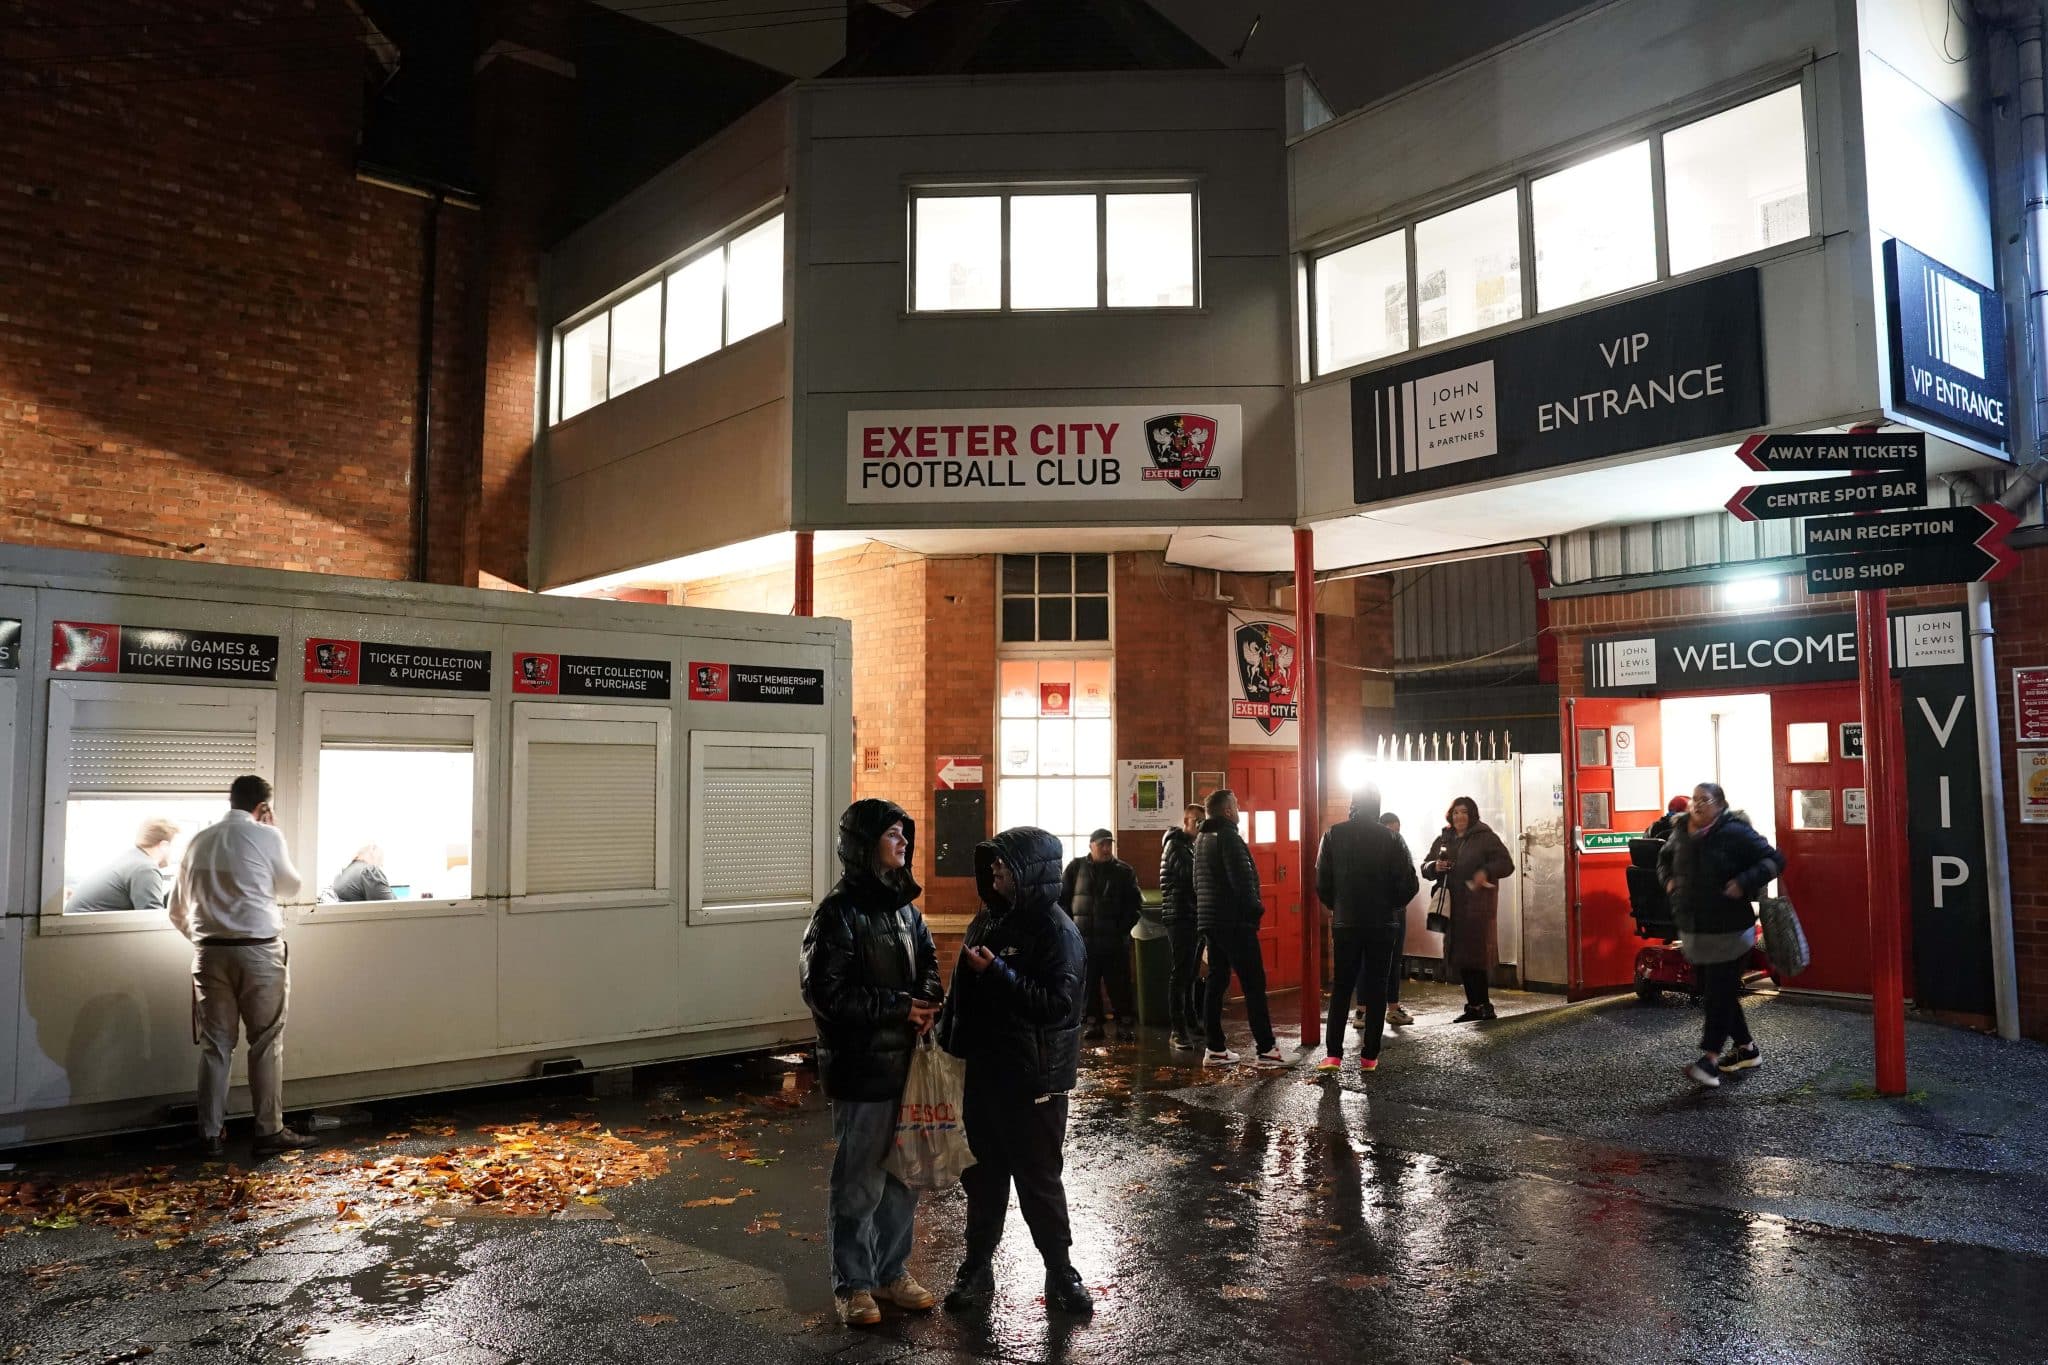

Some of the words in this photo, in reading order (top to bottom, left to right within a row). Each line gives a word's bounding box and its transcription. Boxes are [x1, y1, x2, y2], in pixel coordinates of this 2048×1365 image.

[1600, 332, 1649, 369] VIP
[1432, 380, 1479, 406] JOHN
[1538, 364, 1724, 433] ENTRANCE
[1911, 366, 1932, 397] VIP
[1936, 375, 2004, 426] ENTRANCE
[1428, 405, 1484, 430] LEWIS
[863, 425, 1018, 459] EXETER
[1029, 423, 1120, 456] CITY
[1437, 429, 1485, 447] PARTNERS
[1768, 446, 1814, 460] AWAY
[1817, 446, 1849, 459] FAN
[1851, 445, 1918, 458] TICKETS
[862, 460, 1026, 489] FOOTBALL
[1036, 458, 1121, 487] CLUB
[1145, 469, 1180, 478] EXETER
[1182, 469, 1203, 478] CITY
[1204, 469, 1217, 478] FC
[1766, 491, 1830, 508] CENTRE
[1834, 486, 1878, 503] SPOT
[1881, 482, 1917, 498] BAR
[1809, 527, 1852, 543] MAIN
[1856, 520, 1954, 539] RECEPTION
[1811, 567, 1856, 582] CLUB
[1858, 563, 1905, 579] SHOP
[1917, 621, 1951, 633] JOHN
[140, 638, 187, 651] AWAY
[191, 639, 244, 655] GAMES
[248, 643, 259, 656] &
[1914, 635, 1955, 646] LEWIS
[1622, 647, 1648, 656] JOHN
[1673, 632, 1856, 674] WELCOME
[128, 652, 212, 669] TICKETING
[217, 657, 271, 673] ISSUES
[369, 652, 411, 665] TICKET
[413, 655, 482, 670] COLLECTION
[1620, 658, 1650, 668] LEWIS
[390, 667, 398, 678] &
[401, 668, 463, 682] PURCHASE
[567, 664, 602, 676] TICKET
[604, 667, 664, 680] COLLECTION
[736, 673, 763, 683] TRUST
[764, 675, 817, 686] MEMBERSHIP
[584, 678, 592, 688] &
[595, 678, 647, 691] PURCHASE
[760, 686, 795, 695] ENQUIRY
[1236, 703, 1269, 716] EXETER
[1270, 705, 1289, 717] CITY
[1917, 696, 1970, 908] VIP
[1597, 836, 1613, 844] Push
[1613, 835, 1623, 843] bar
